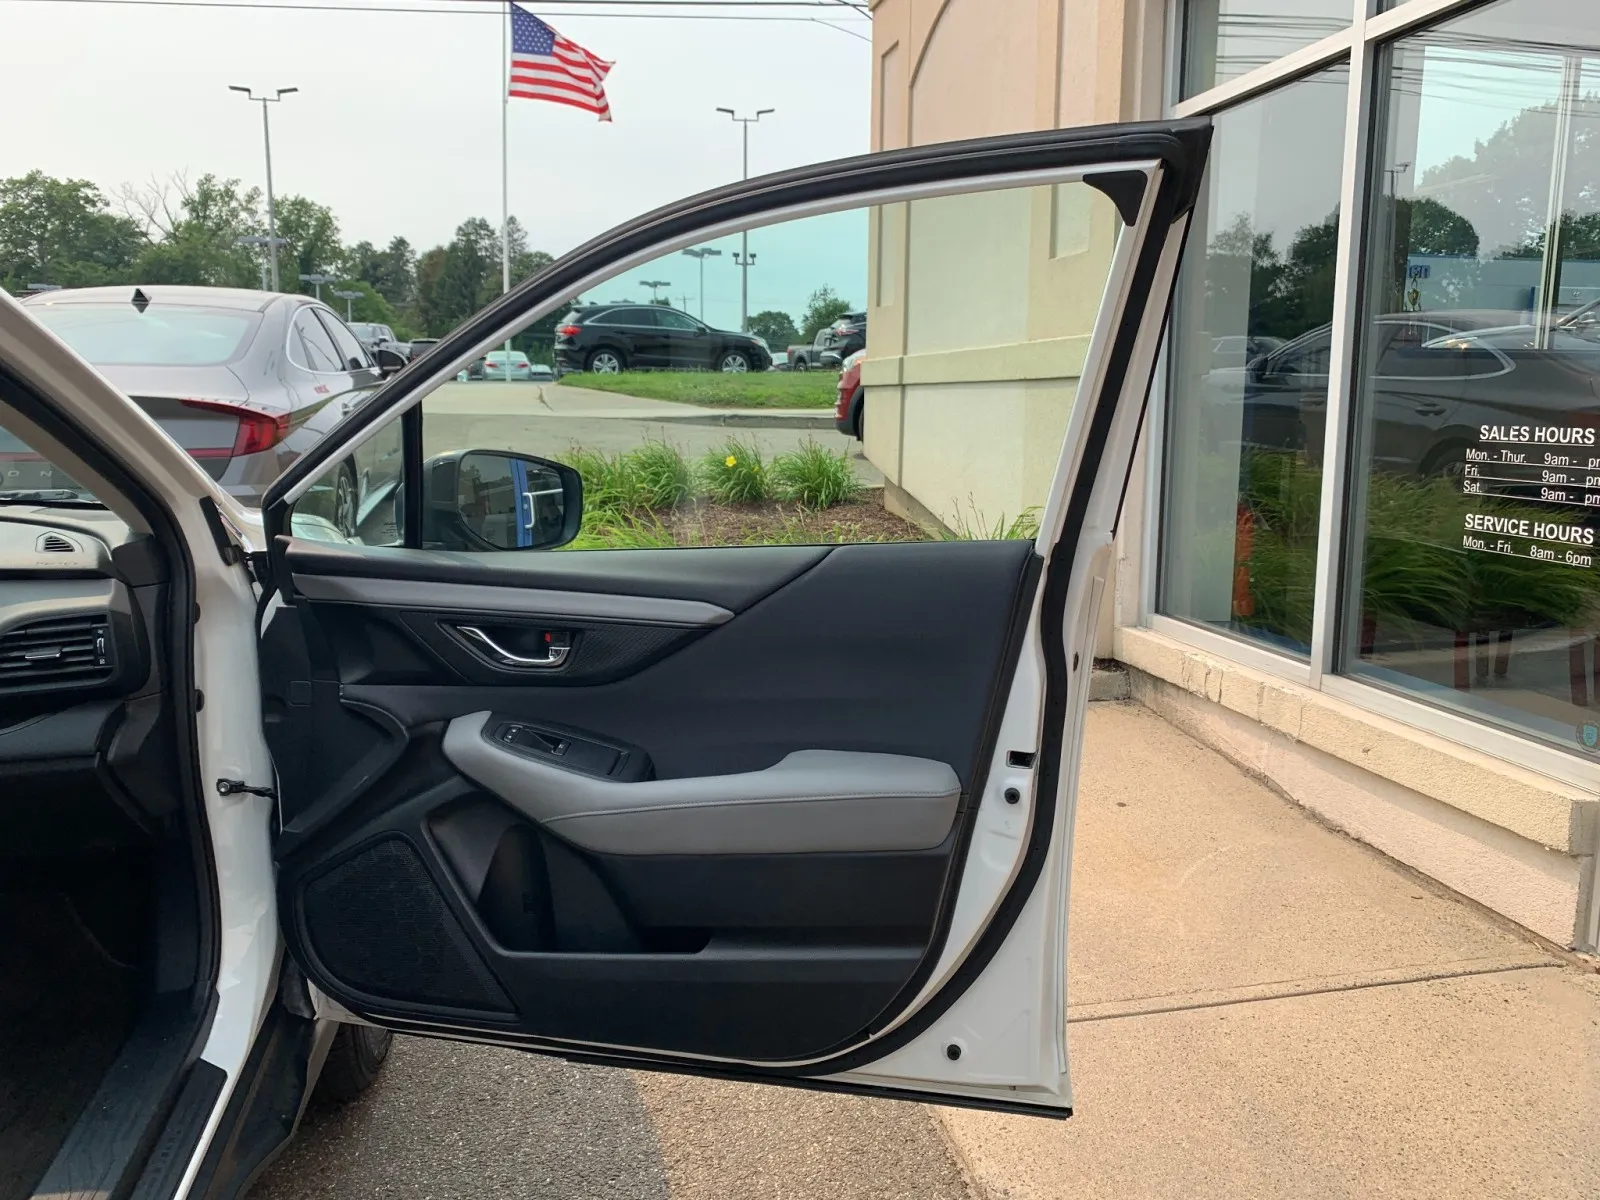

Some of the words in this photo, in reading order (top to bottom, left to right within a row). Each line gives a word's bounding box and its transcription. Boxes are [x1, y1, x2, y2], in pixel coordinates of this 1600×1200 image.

[1480, 425, 1530, 441] SALES
[1534, 426, 1596, 444] HOURS
[1466, 448, 1490, 460] Mon.
[1501, 450, 1527, 463] Thur.
[1544, 452, 1569, 466] 9am
[1464, 464, 1480, 477] Fri.
[1541, 470, 1567, 483] 9am
[1463, 480, 1482, 493] Sat.
[1540, 487, 1566, 501] 9am
[1464, 513, 1530, 536] SERVICE
[1533, 522, 1594, 545] HOURS
[1463, 535, 1487, 550] Mon.
[1497, 541, 1514, 554] Fri.
[1530, 545, 1555, 560] 8am
[1565, 550, 1592, 566] 6pm
